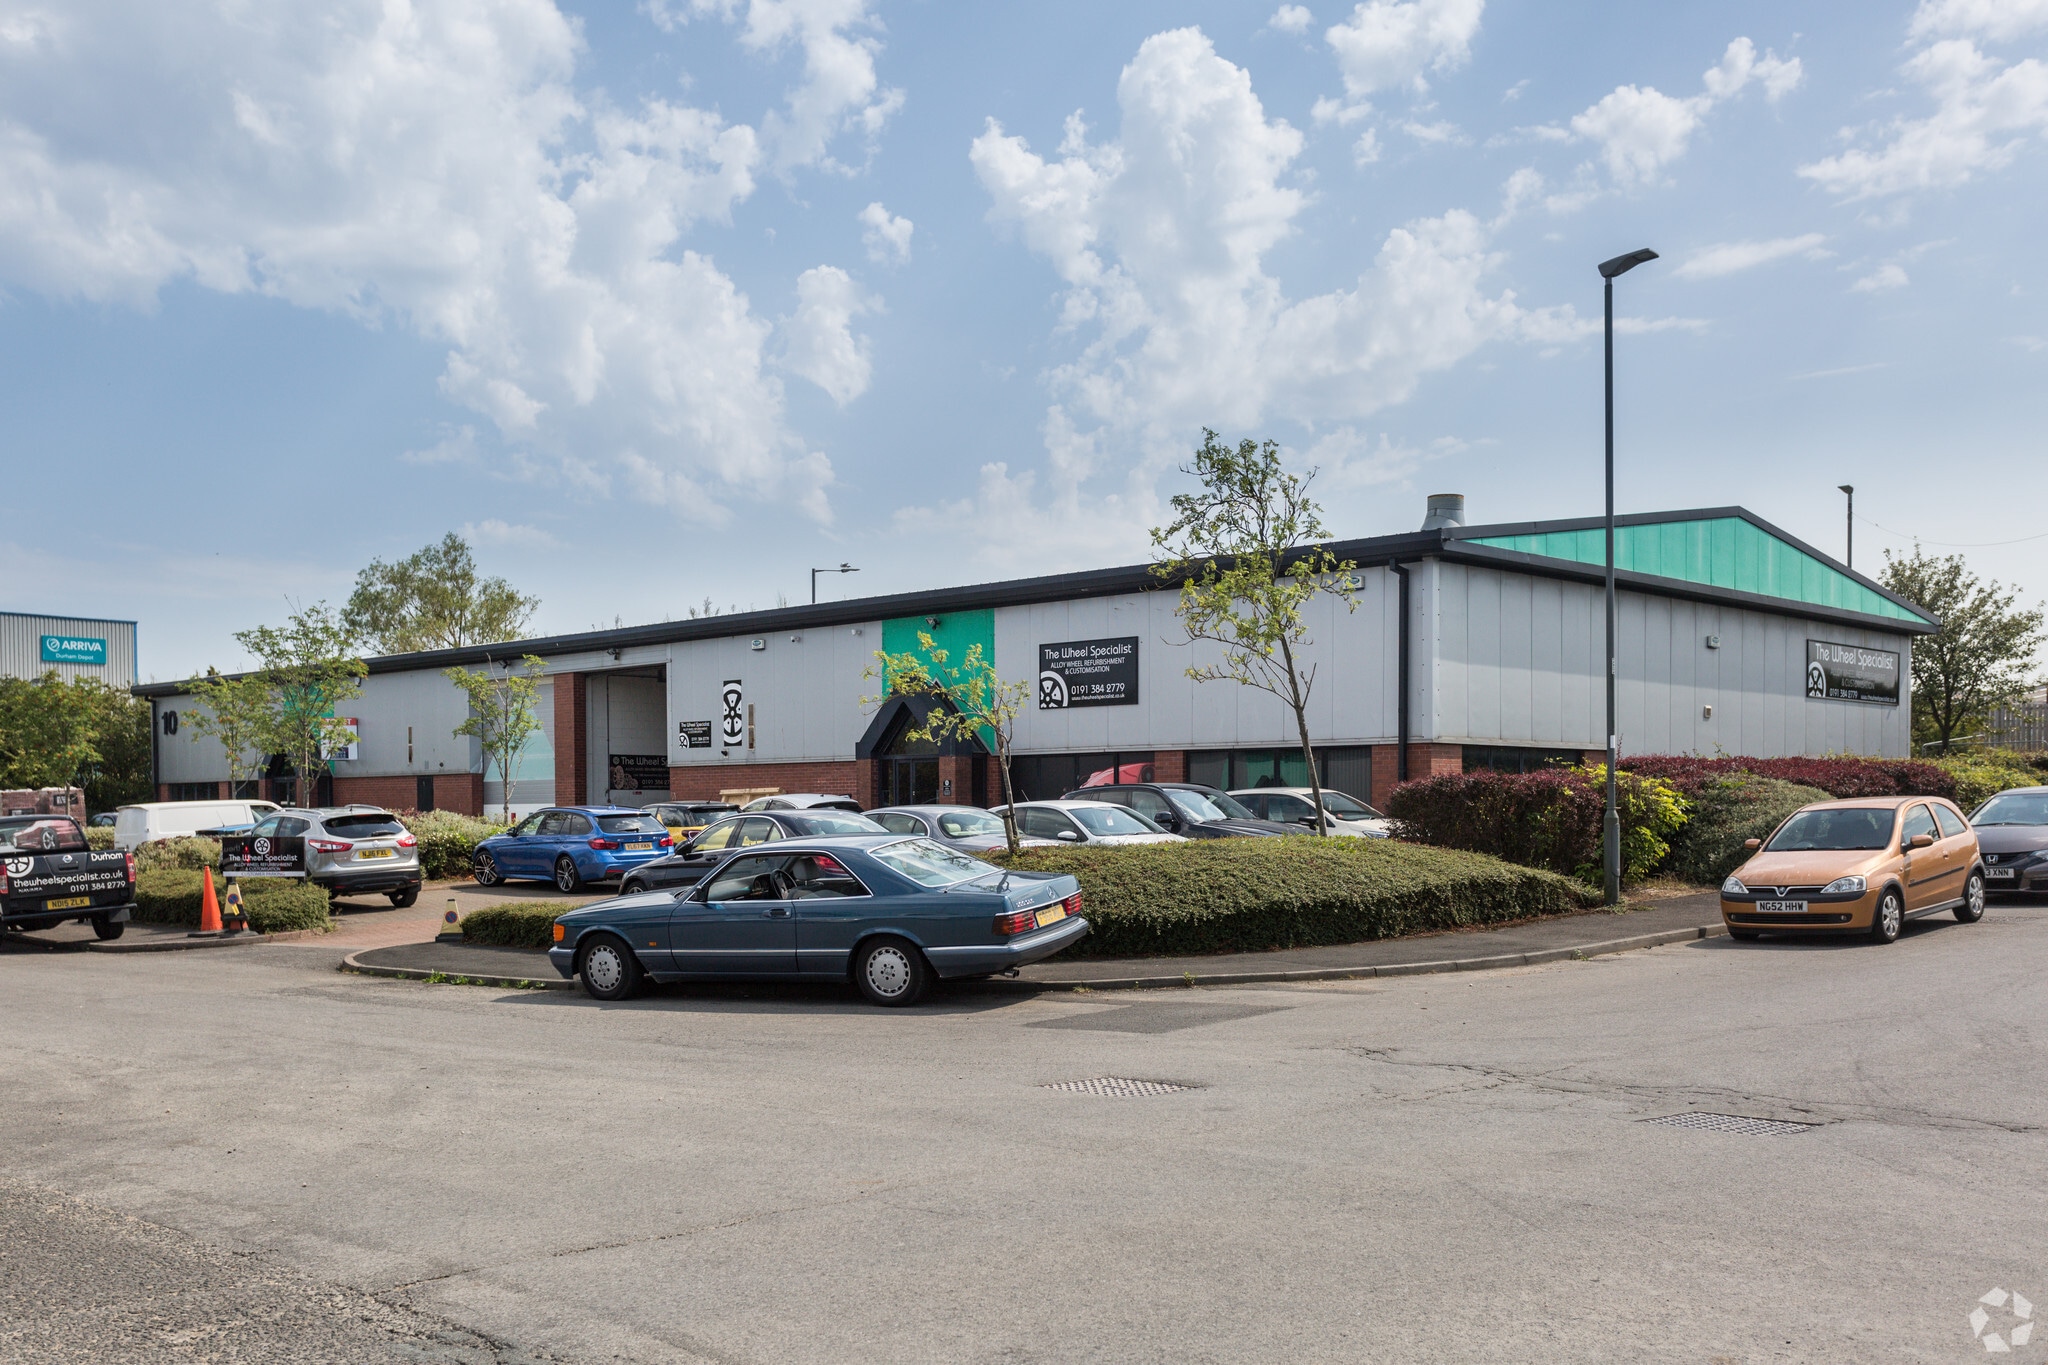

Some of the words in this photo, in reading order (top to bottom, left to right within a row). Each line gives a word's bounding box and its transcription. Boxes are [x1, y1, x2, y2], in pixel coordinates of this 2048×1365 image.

[62, 640, 102, 652] ARRIVA
[1045, 649, 1059, 659] The
[1061, 647, 1088, 658] Wheel
[1090, 644, 1132, 658] Specialist
[1084, 657, 1125, 666] REFURBISHMENT
[1815, 643, 1830, 660] The
[1831, 645, 1856, 664] Wheel
[1858, 649, 1893, 670] Specialist
[1069, 666, 1110, 674] CUSTOMISATION
[1071, 685, 1088, 694] 0191
[1091, 684, 1104, 693] 384
[1106, 683, 1125, 692] 2779
[1829, 688, 1839, 697] 0191
[1848, 690, 1858, 699] 2779
[162, 711, 178, 735] 10
[621, 757, 634, 765] The
[637, 757, 660, 766] Wheel
[91, 852, 123, 862] Durham
[265, 854, 298, 863] Specialist
[14, 870, 123, 887] thewheelspecialist.co.uk
[70, 884, 89, 893] 0191
[92, 882, 105, 891] 384
[107, 881, 126, 889] 2779
[70, 898, 86, 906] ZLK
[1760, 902, 1783, 911] NG52
[1785, 902, 1803, 910] HHW
